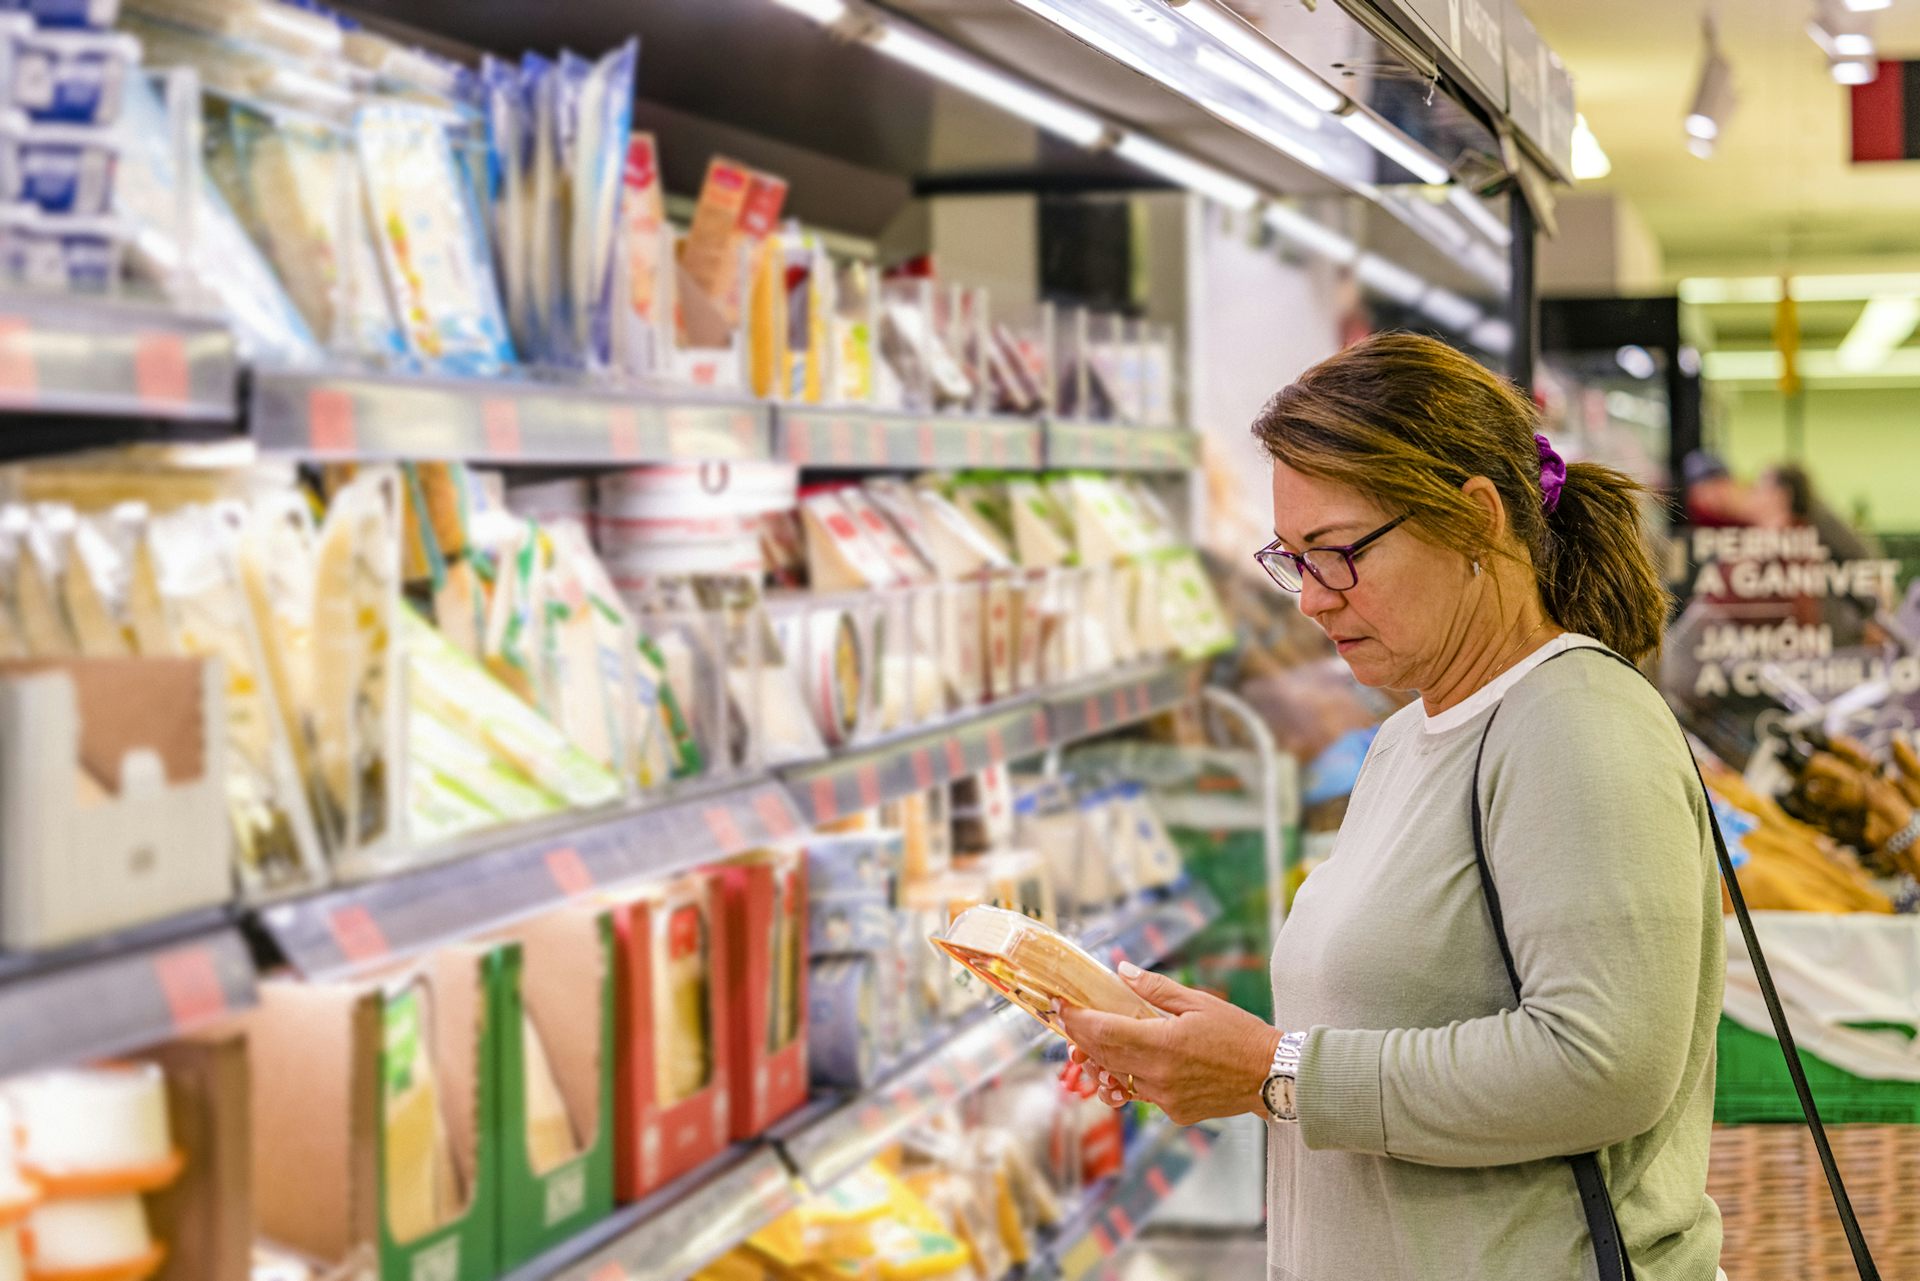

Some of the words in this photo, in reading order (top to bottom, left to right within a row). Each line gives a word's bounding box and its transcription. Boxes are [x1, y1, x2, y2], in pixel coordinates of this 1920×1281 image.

[1693, 526, 1829, 563] PERNIL
[1693, 562, 1726, 597] A
[1729, 559, 1900, 599] GANIVET
[1694, 616, 1833, 661] JAMÓN
[1694, 663, 1729, 697] A
